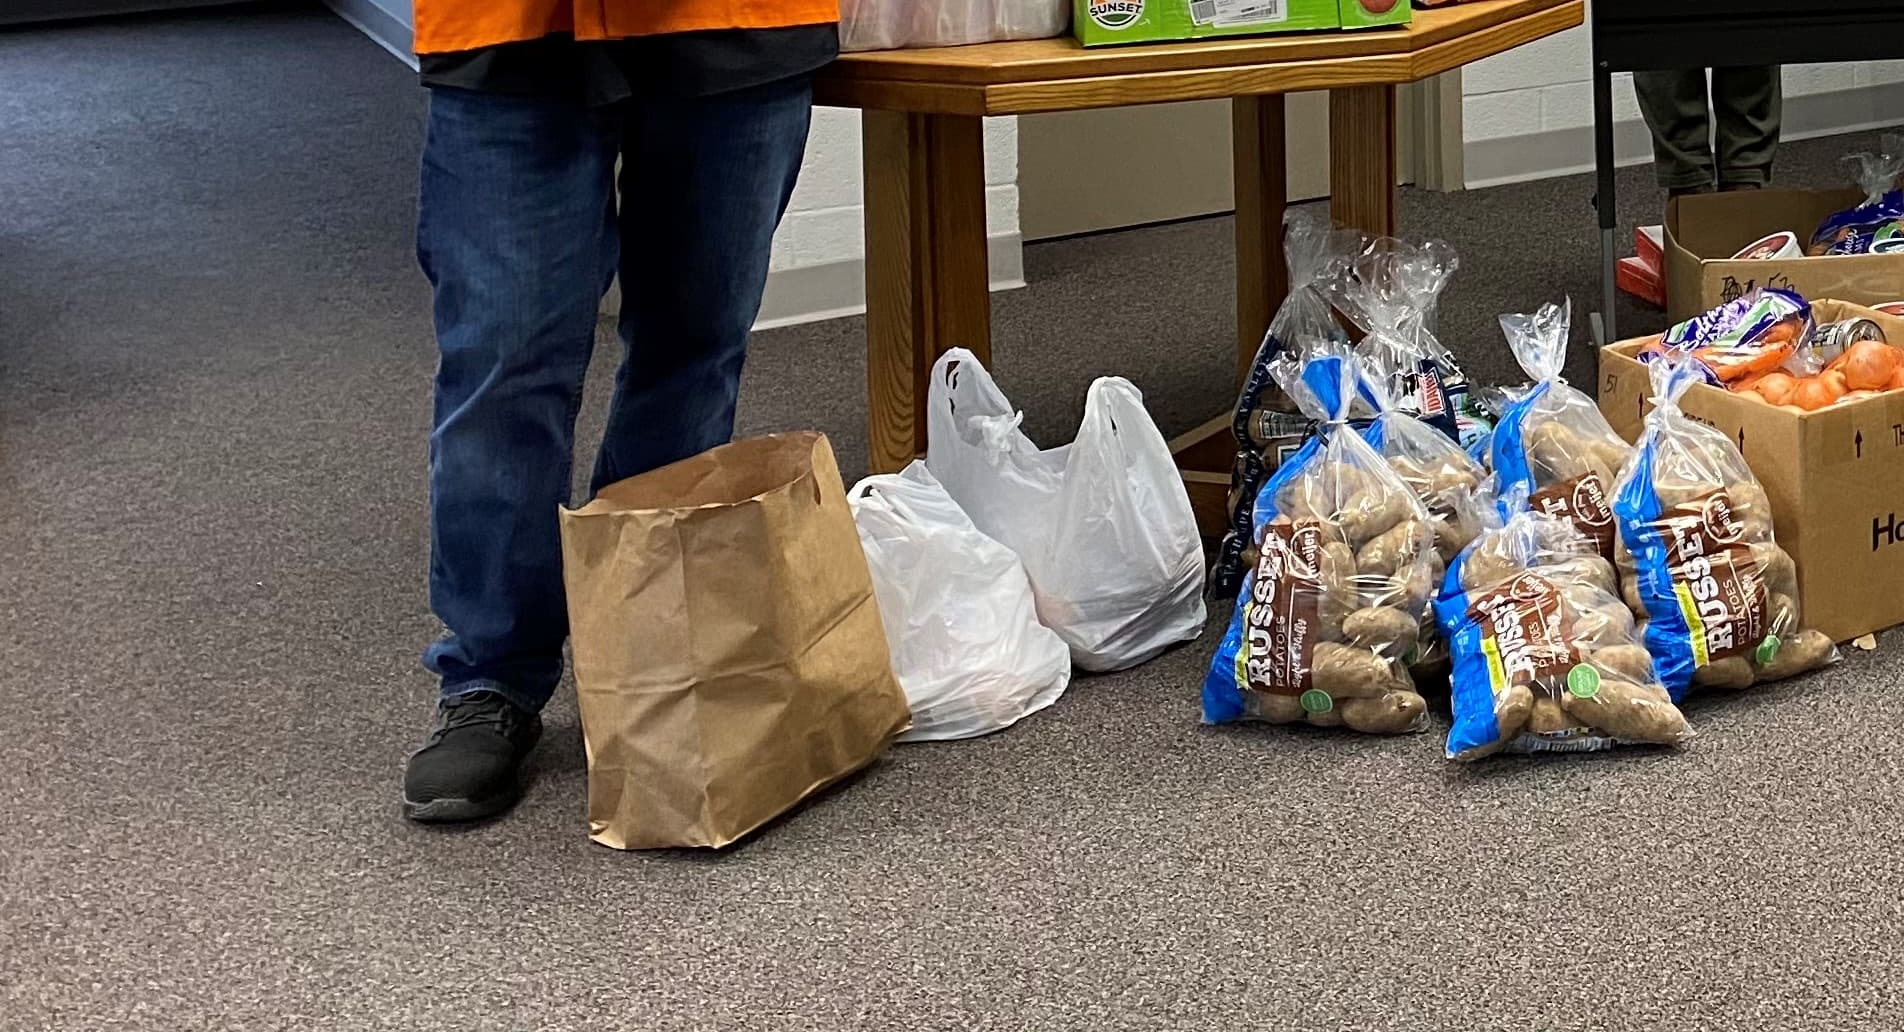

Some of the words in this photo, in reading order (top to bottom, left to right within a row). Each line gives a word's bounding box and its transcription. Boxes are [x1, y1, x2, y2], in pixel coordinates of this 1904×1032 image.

[1090, 3, 1143, 17] SUNSET
[1587, 481, 1611, 518] meijer
[1302, 531, 1316, 574] meijer
[1671, 516, 1733, 654] RUSSET
[1248, 531, 1285, 688] RUSSET
[1476, 593, 1534, 672] RUSSET
[1722, 578, 1747, 646] POTATOES
[1275, 615, 1286, 688] POTATOES
